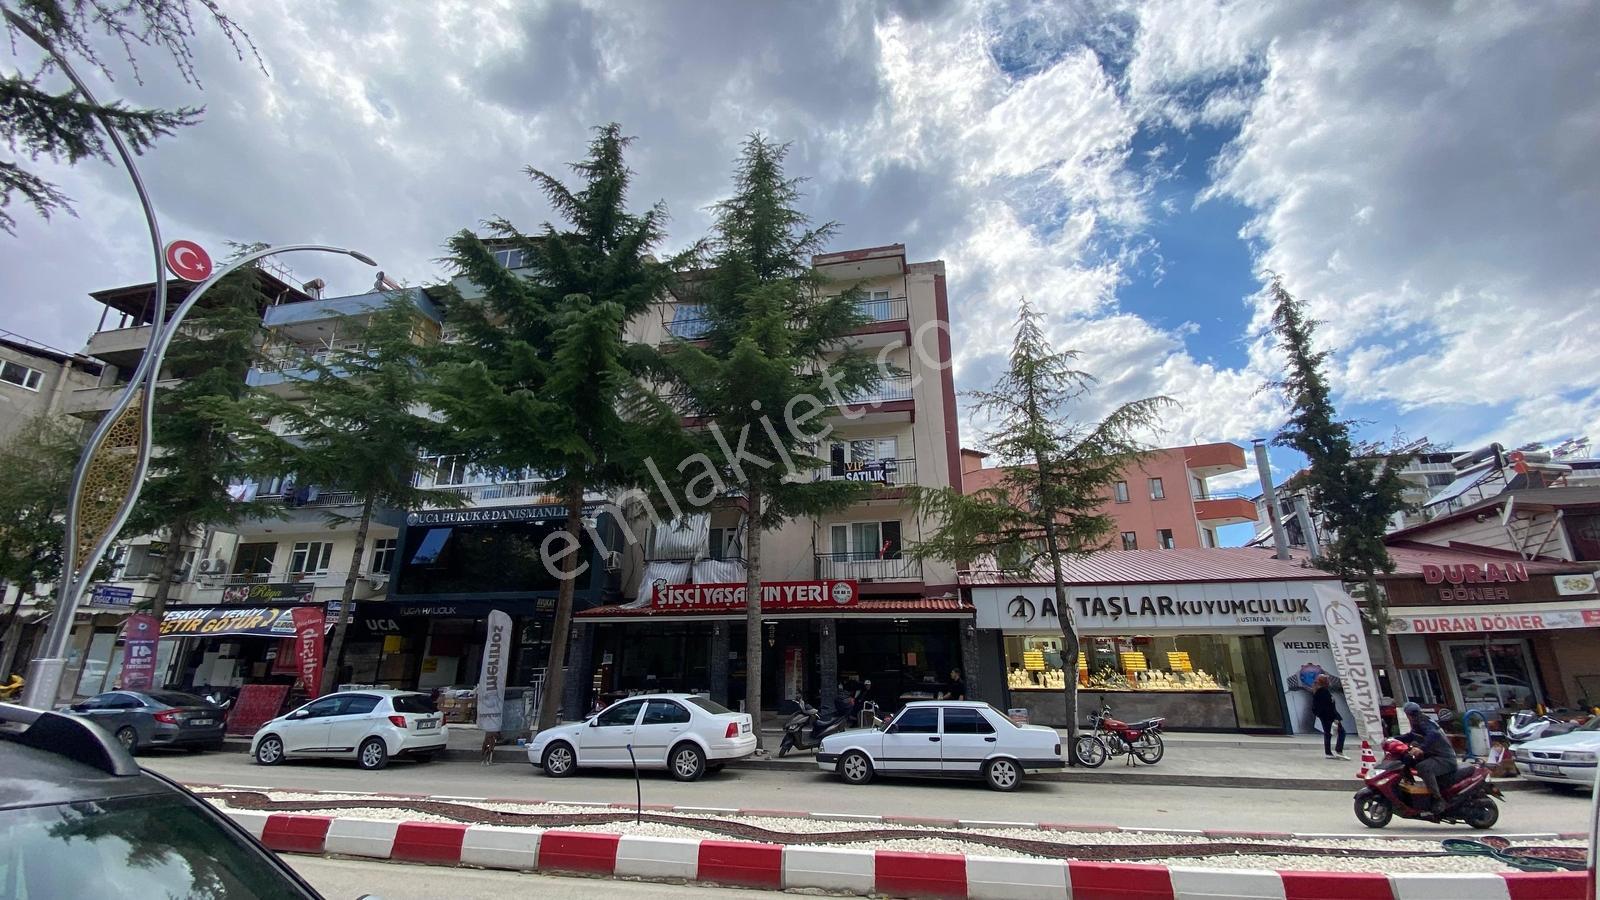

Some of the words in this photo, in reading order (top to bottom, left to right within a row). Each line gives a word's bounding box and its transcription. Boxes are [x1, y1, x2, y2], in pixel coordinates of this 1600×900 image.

[846, 470, 885, 482] SATILIK
[418, 512, 439, 524] UCA
[441, 511, 479, 522] HUKUK
[482, 509, 491, 520] &
[1422, 561, 1530, 585] DURAN
[657, 584, 700, 609] ŞİŞÇİ
[780, 580, 829, 604] YERİ
[1438, 583, 1510, 601] DÖNER
[1041, 595, 1176, 622] ATAŞLAR
[1176, 598, 1312, 616] KUYUMCULUK
[365, 619, 400, 631] UCA
[1412, 616, 1478, 633] DURAN
[1480, 613, 1546, 630] DÖNER
[1283, 641, 1330, 650] WELDER
